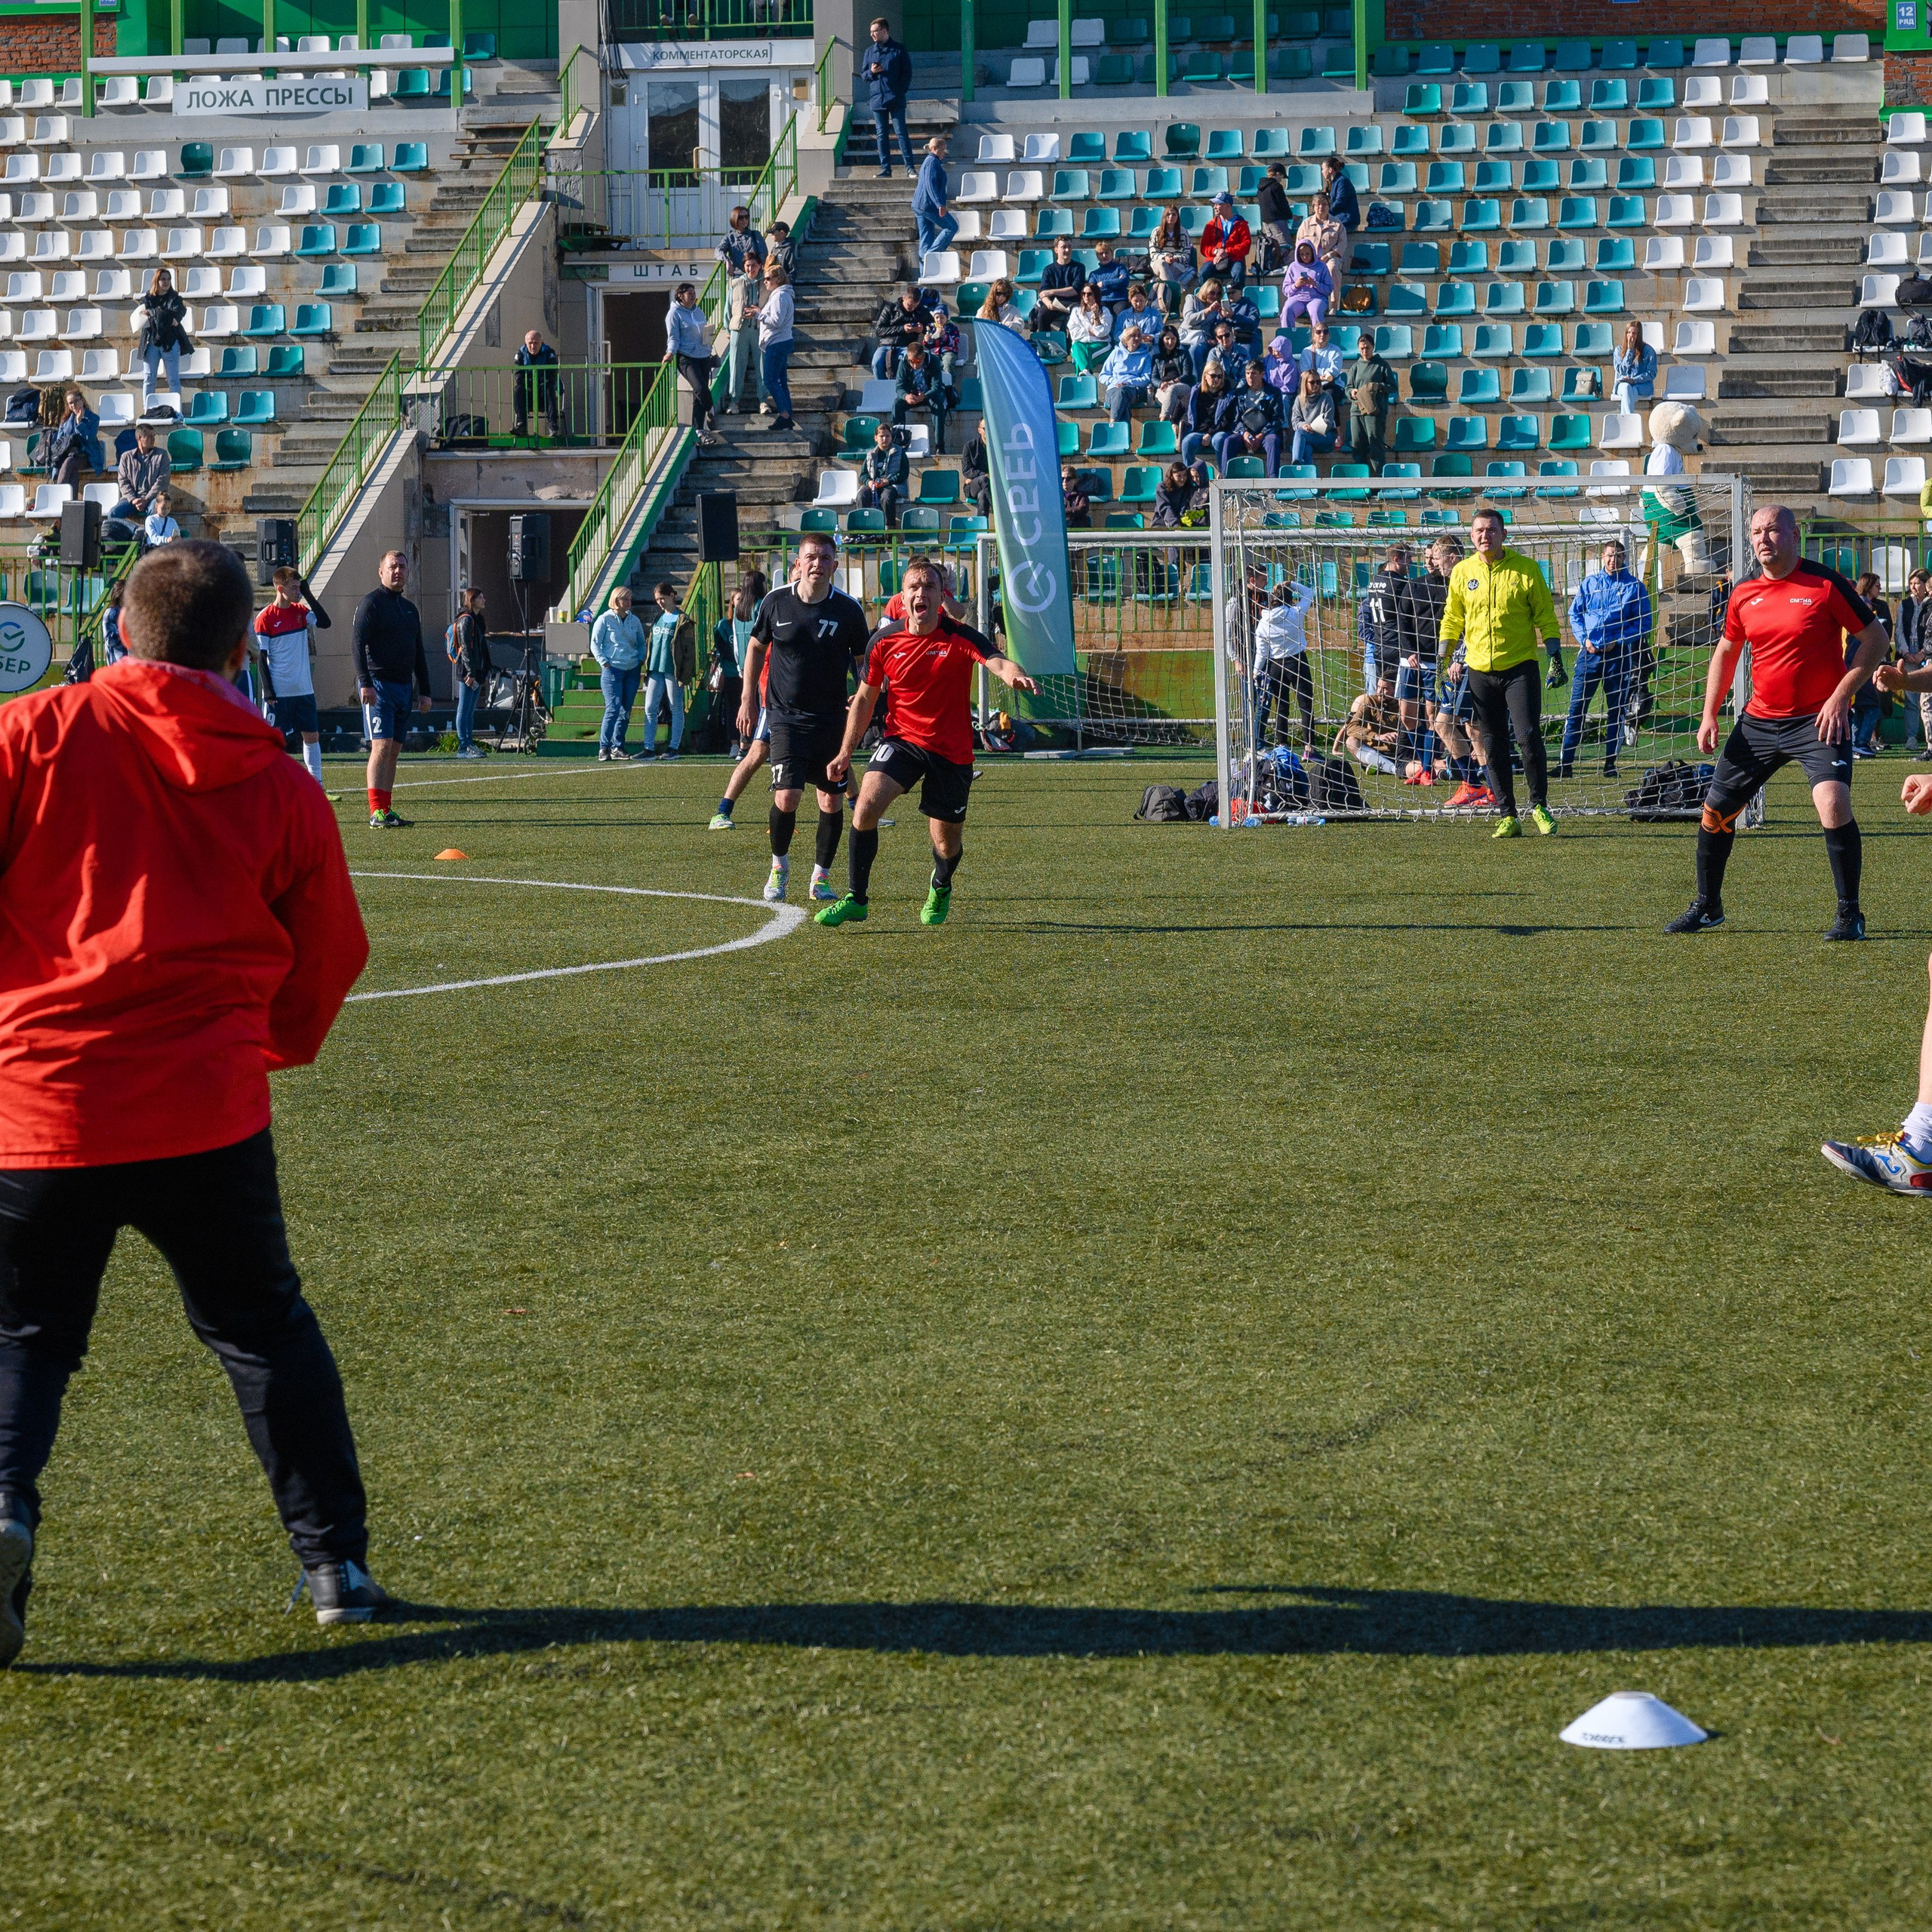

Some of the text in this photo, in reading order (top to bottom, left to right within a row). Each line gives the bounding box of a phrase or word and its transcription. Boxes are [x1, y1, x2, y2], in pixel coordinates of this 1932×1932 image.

[1899, 6, 1914, 16] 12
[653, 49, 768, 60] КОММЕНТАТОРСКАЯ
[186, 87, 353, 109] ЛОЖА ПРЕССЫ
[633, 264, 698, 277] ШТАБ
[1369, 598, 1386, 623] 11
[817, 619, 838, 638] 77
[372, 716, 383, 734] 2
